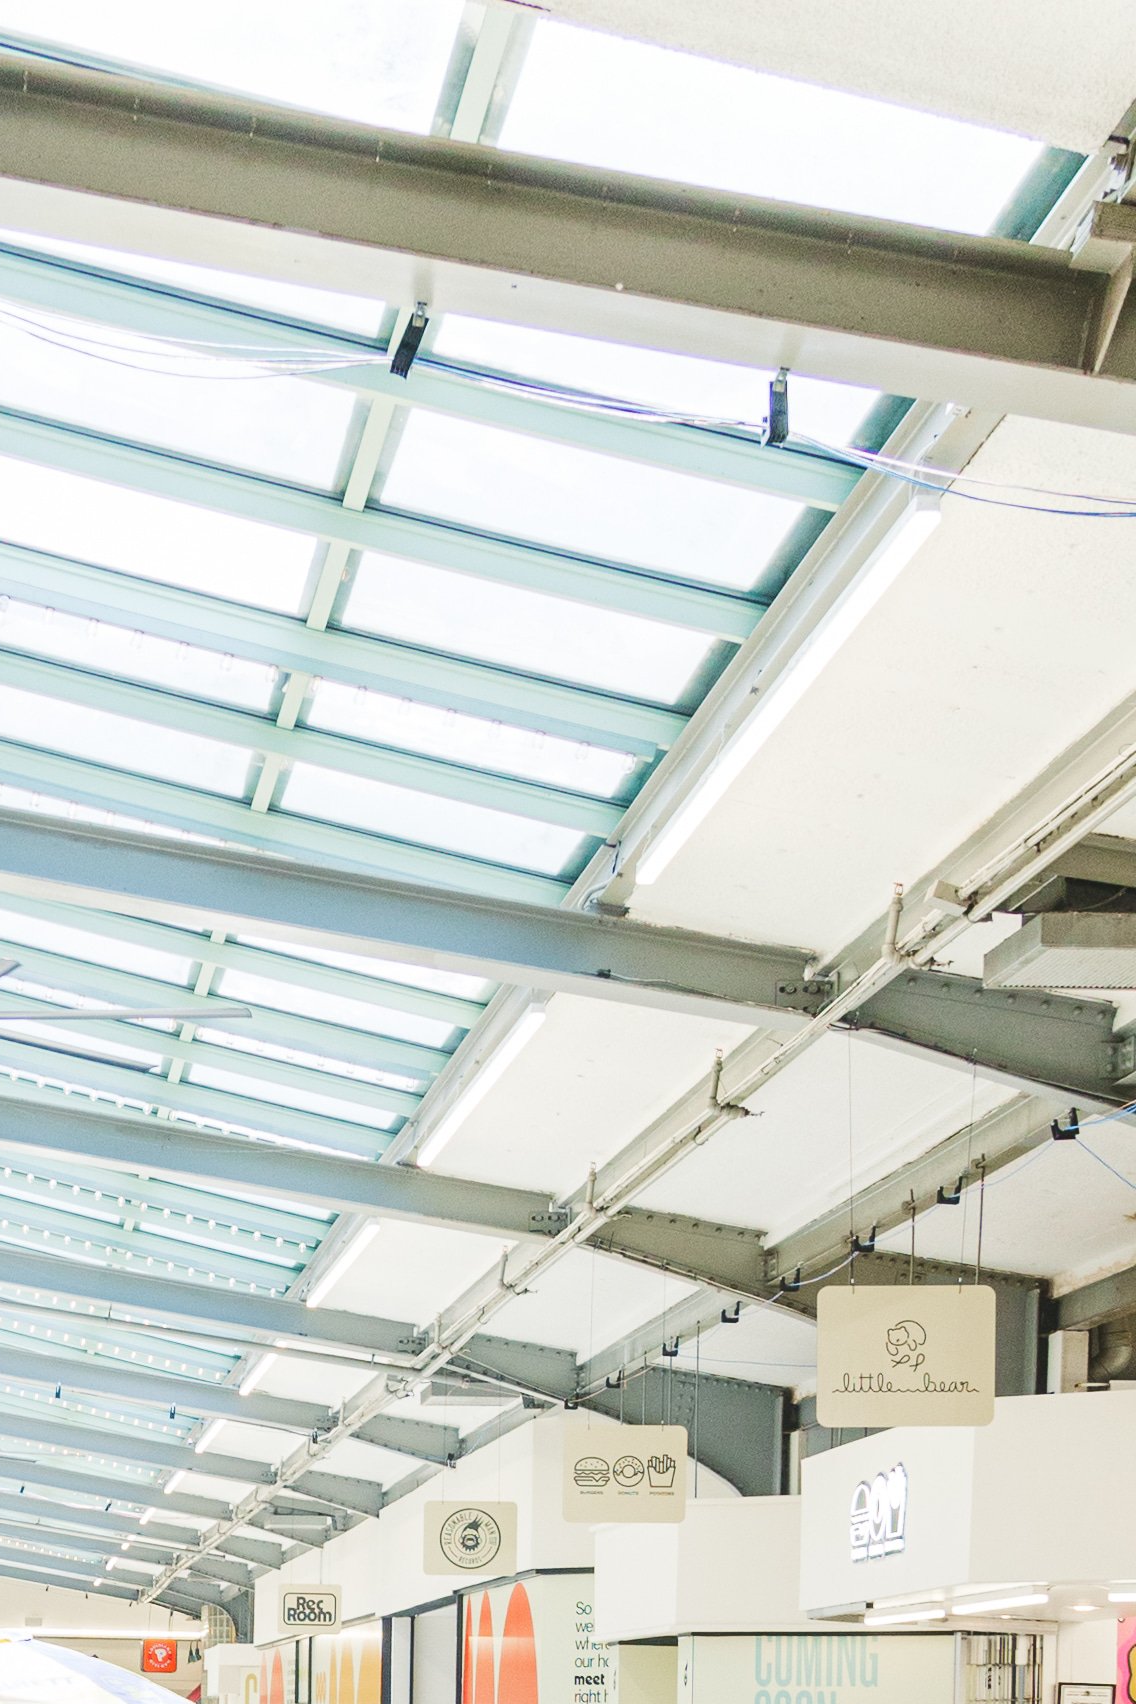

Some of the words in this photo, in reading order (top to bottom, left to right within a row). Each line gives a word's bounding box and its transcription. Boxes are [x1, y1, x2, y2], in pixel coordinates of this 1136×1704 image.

[834, 1372, 895, 1394] little
[914, 1372, 980, 1394] bear
[297, 1596, 324, 1611] Rec
[575, 1601, 592, 1615] So
[287, 1608, 333, 1622] Room
[574, 1657, 594, 1668] our
[754, 1636, 879, 1687] COMING
[574, 1674, 605, 1686] meet
